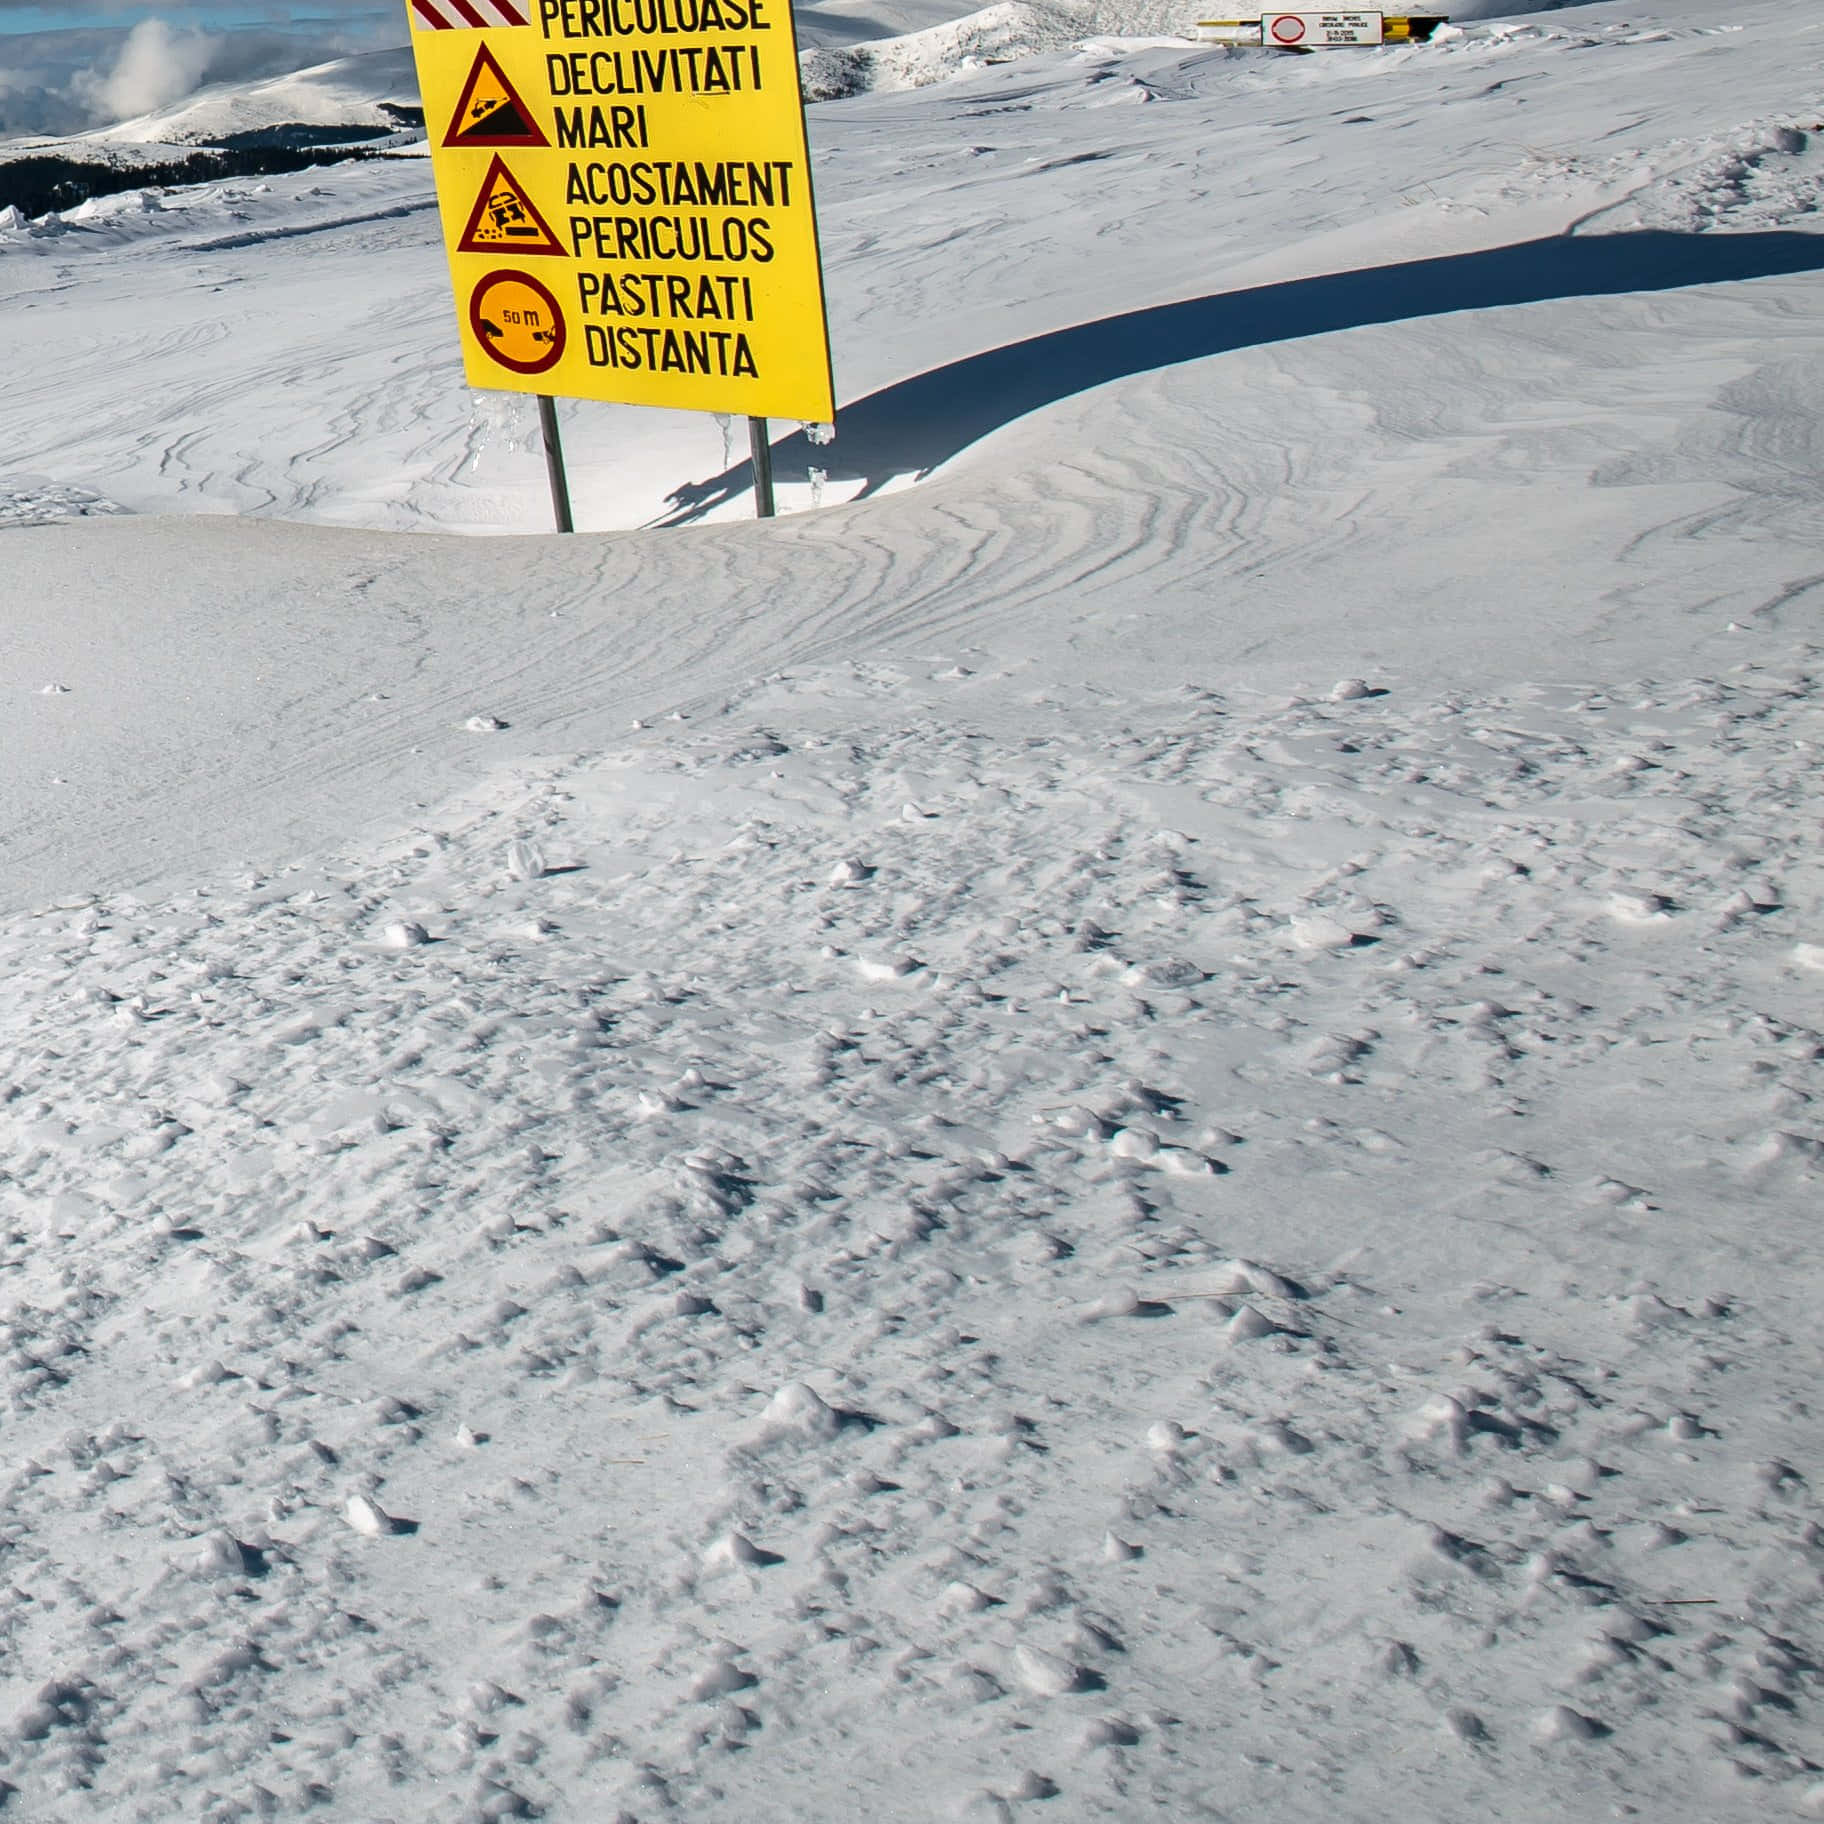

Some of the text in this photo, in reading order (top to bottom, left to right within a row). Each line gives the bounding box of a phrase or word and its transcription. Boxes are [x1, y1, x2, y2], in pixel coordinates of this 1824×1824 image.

[546, 45, 762, 96] DECLIVITATI
[553, 104, 649, 149] MARI
[566, 161, 793, 208] ACOSTAMENT
[569, 216, 774, 263] PERICULOS
[578, 272, 754, 322] PASTRATI
[584, 325, 759, 379] DISTANTA
